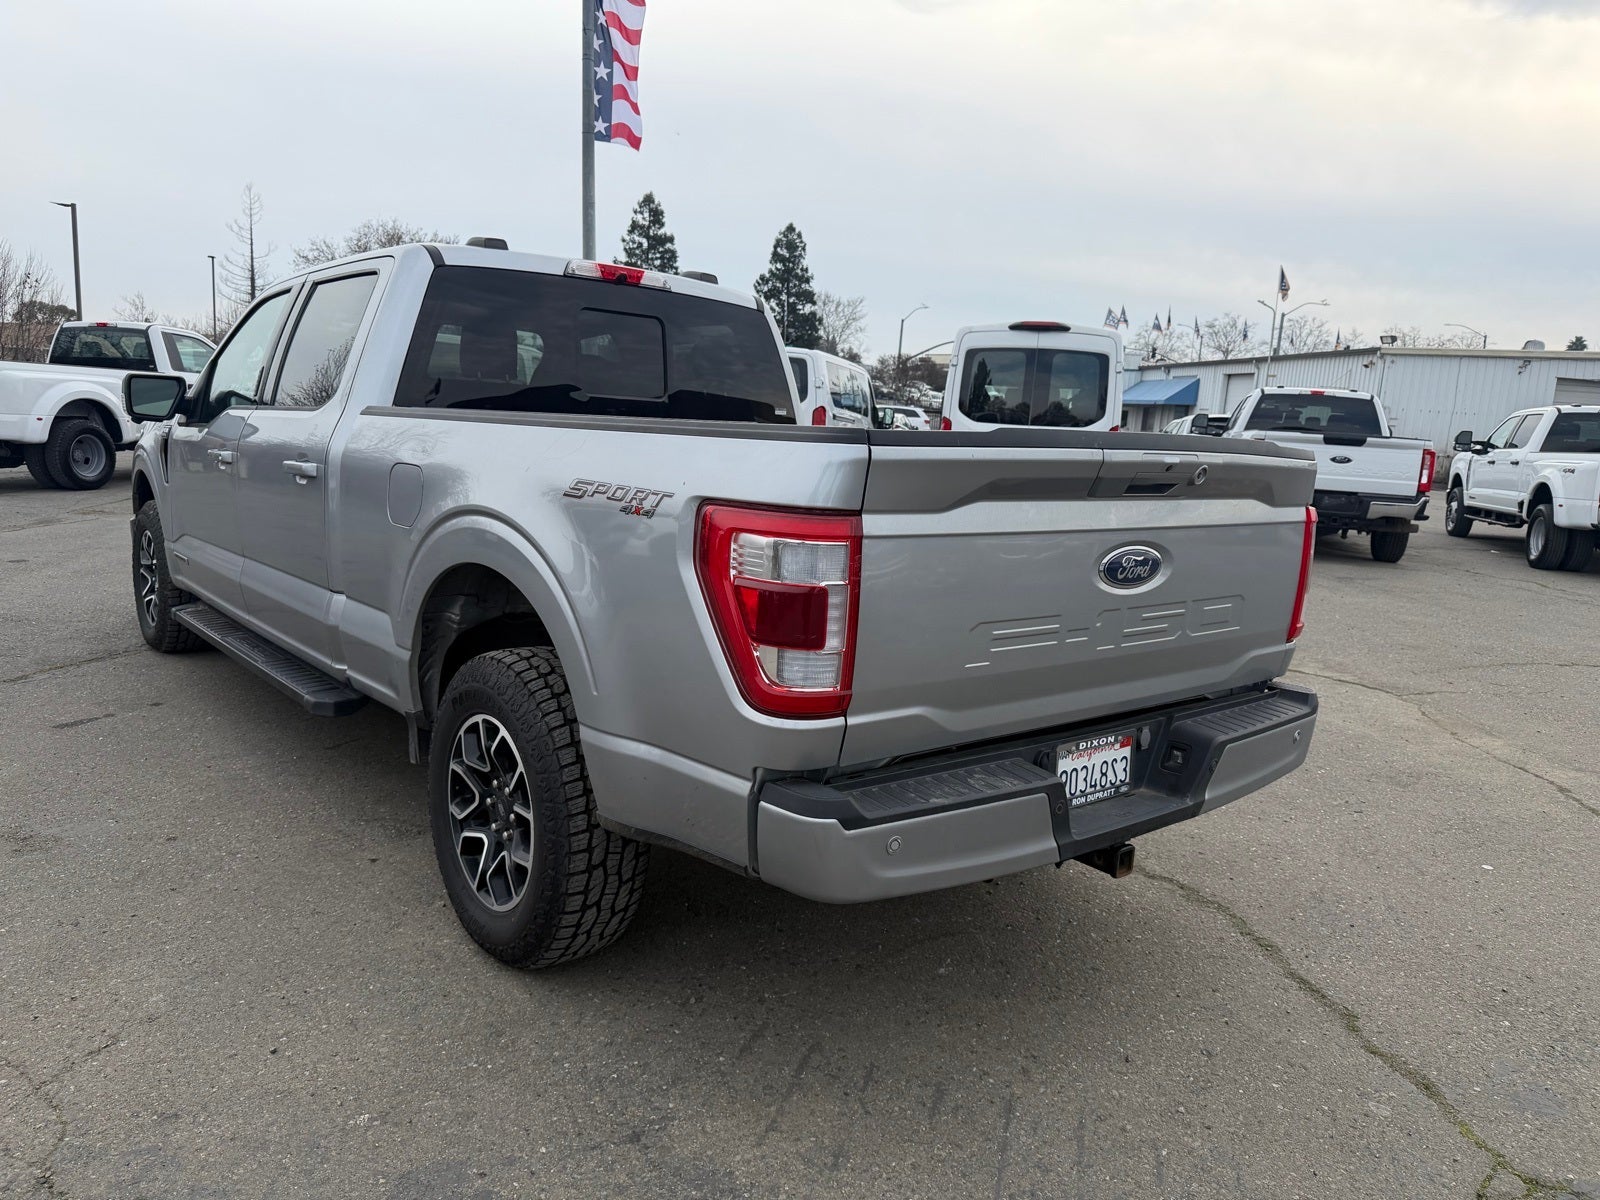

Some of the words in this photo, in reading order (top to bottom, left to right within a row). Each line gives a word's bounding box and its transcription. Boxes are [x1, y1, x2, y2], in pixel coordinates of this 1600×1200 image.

[563, 478, 675, 508] SPORT
[1117, 555, 1152, 580] Ford
[1079, 736, 1115, 750] DIXON
[1072, 796, 1086, 806] RON
[1087, 788, 1115, 802] DUPRATT
